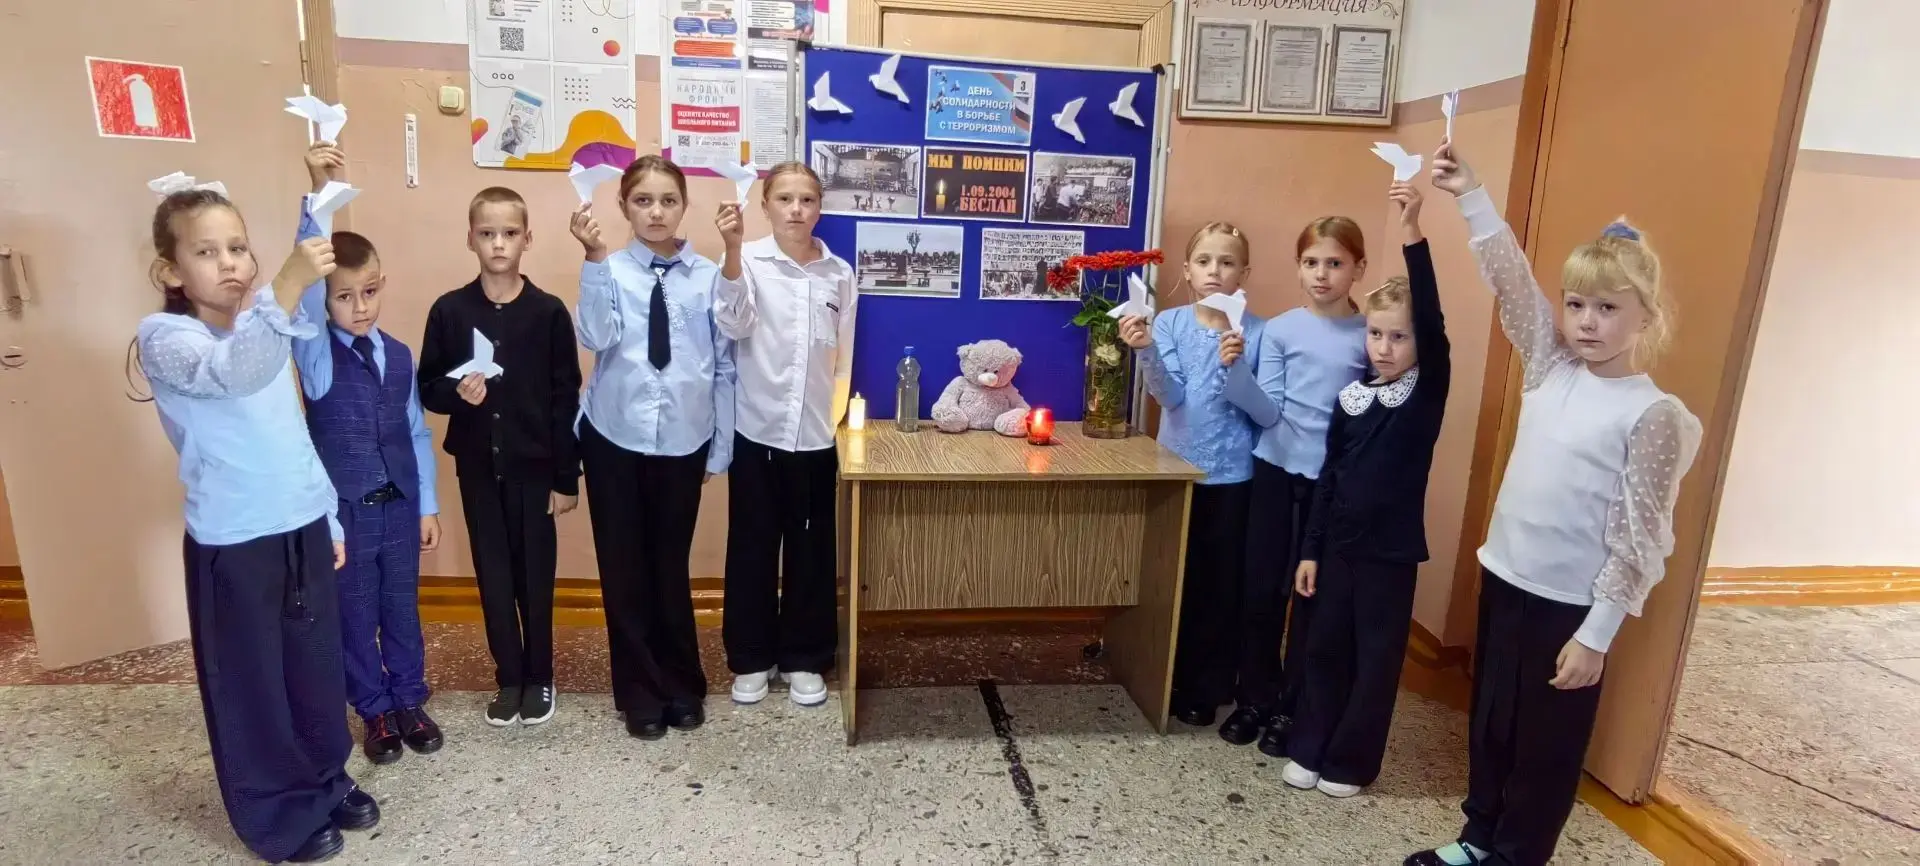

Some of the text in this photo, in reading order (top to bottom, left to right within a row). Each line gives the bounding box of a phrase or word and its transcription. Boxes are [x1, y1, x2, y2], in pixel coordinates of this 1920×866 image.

[967, 86, 993, 96] ДЕНЬ
[1020, 80, 1026, 92] 3
[942, 96, 1016, 110] СОЛИДАРНОСТИ
[957, 110, 1001, 121] В БОРЬБЕ
[939, 121, 1016, 135] С ТЕРРОРИЗМОМ
[927, 153, 1025, 172] МЫ ПОМНИМ
[960, 184, 1017, 198] 1.09.2004
[959, 197, 1017, 213] БЕСЛАН
